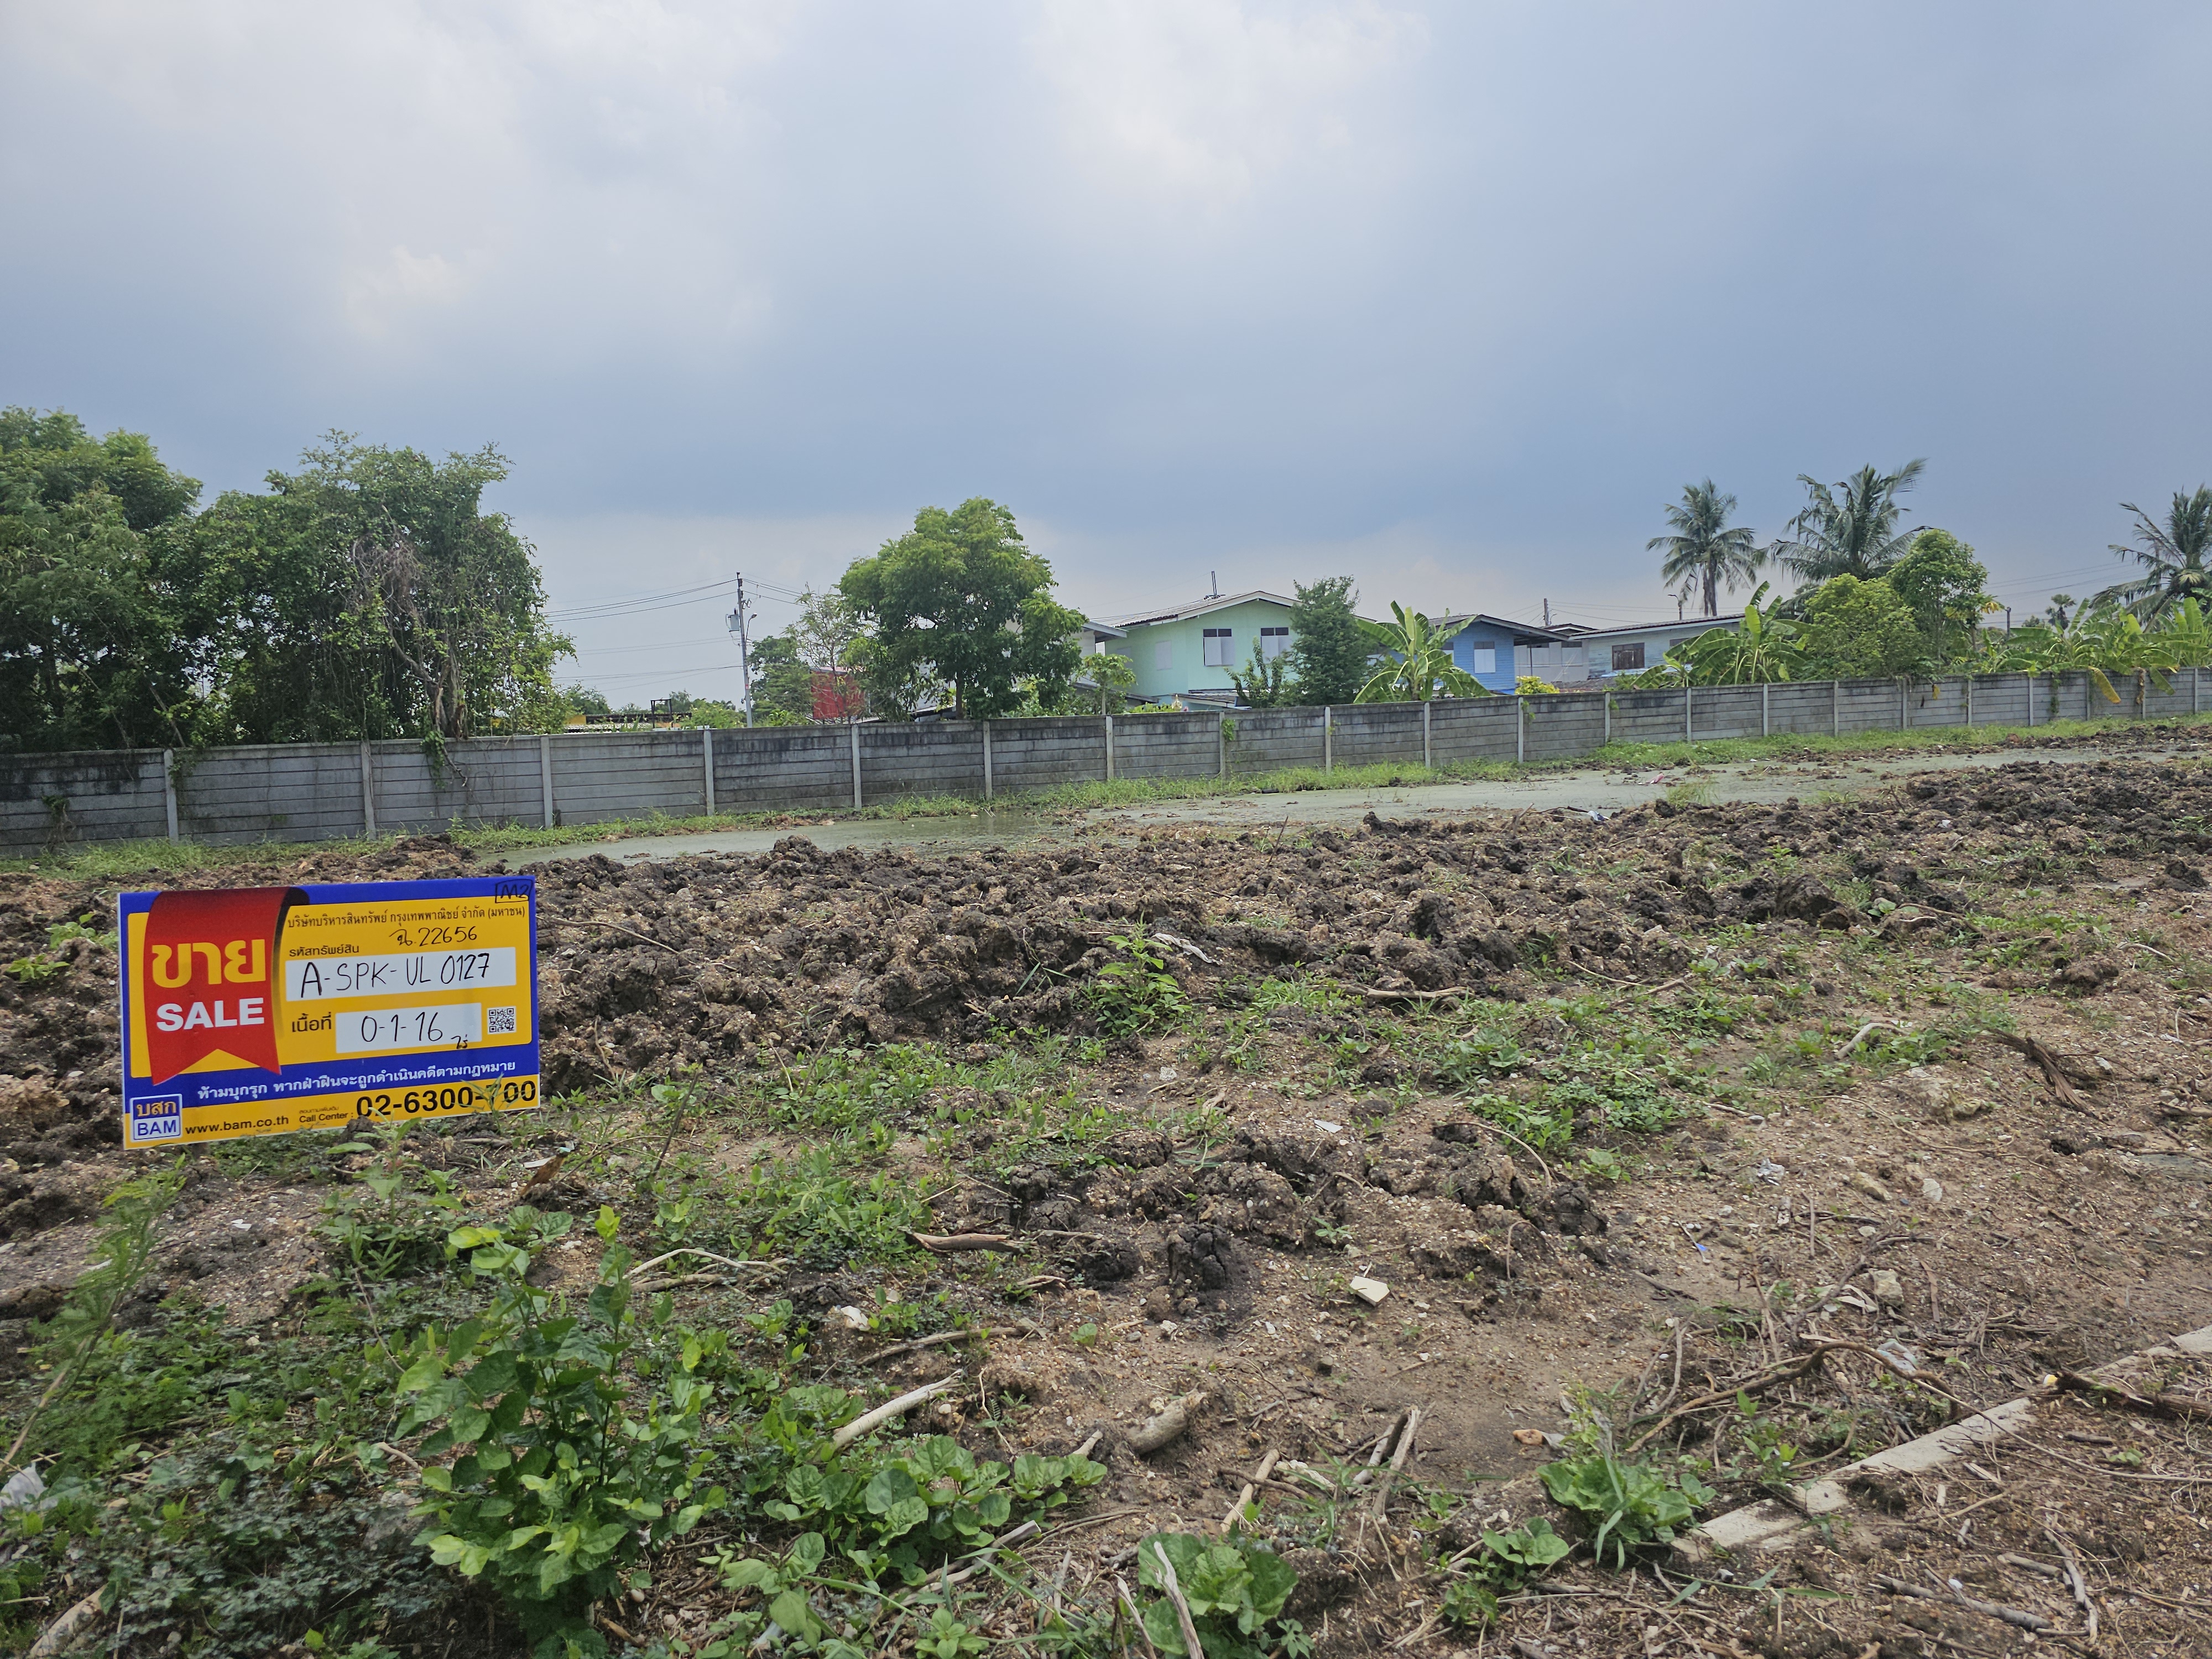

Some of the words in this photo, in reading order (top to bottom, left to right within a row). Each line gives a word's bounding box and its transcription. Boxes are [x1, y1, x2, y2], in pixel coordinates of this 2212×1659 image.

[288, 909, 388, 928] บริษัทบริหารสินทรัพย์
[390, 905, 460, 927] กรุงเทพพาณิชย์
[461, 905, 486, 919] จำกัด
[487, 906, 525, 920] (มหาชน)
[289, 943, 359, 957] รหัสทรัพย์สิน
[152, 938, 266, 988] ขาย
[156, 997, 265, 1032] SALE
[291, 1011, 332, 1033] เนื้อที่
[197, 1086, 268, 1100] ห้ามบุกรุก
[136, 1100, 177, 1117] บสก
[185, 1115, 289, 1135] www.bam.co.th
[299, 1115, 316, 1123] Call
[319, 1113, 348, 1121] Center
[138, 1119, 177, 1136] BAM
